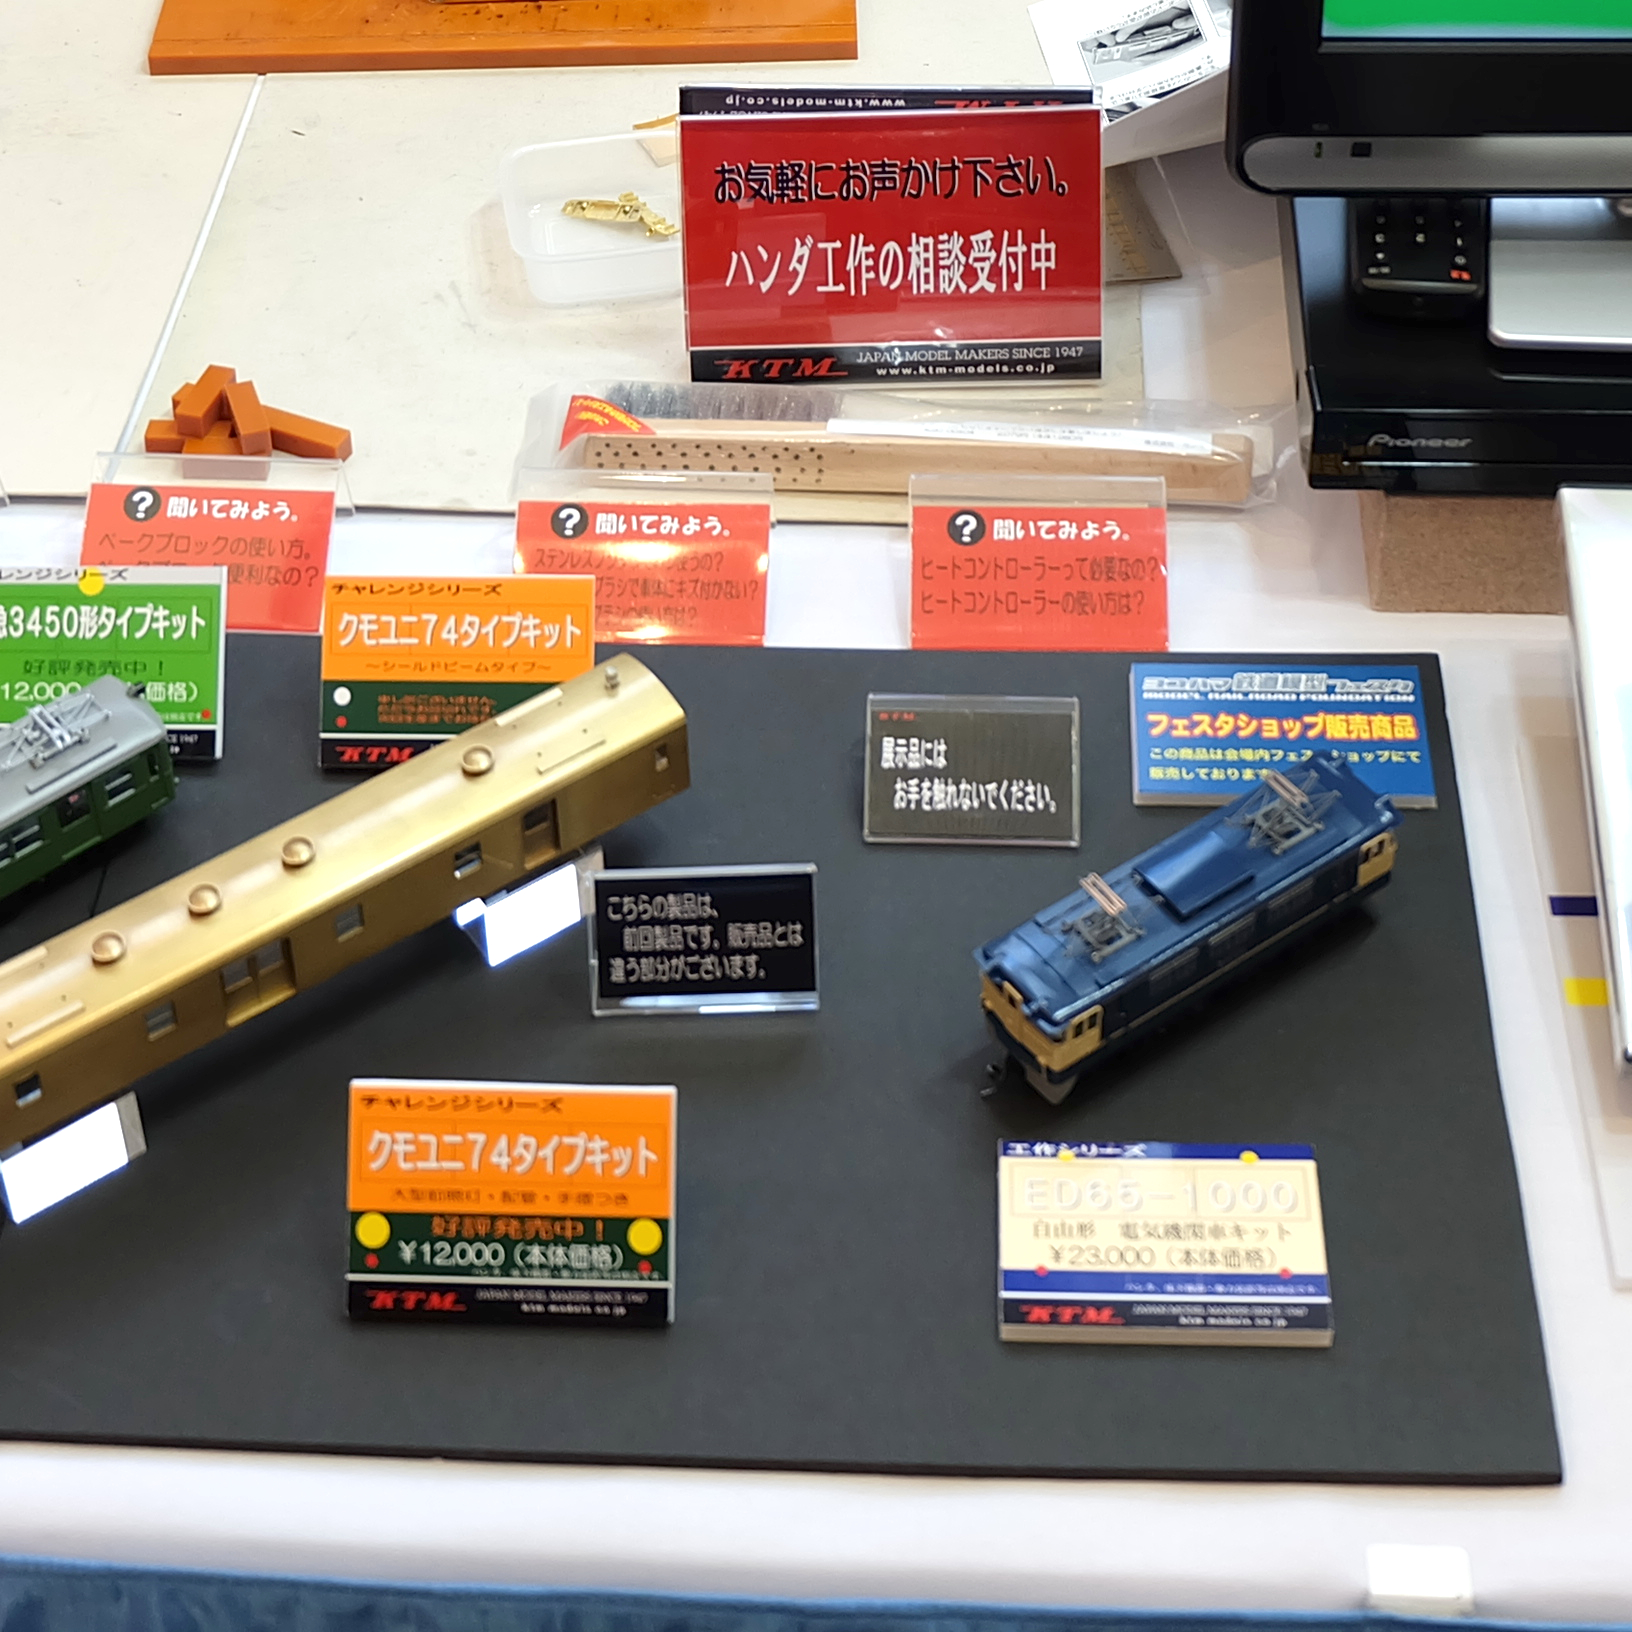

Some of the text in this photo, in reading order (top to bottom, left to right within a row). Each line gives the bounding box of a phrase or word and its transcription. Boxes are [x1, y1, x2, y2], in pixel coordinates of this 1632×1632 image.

[713, 155, 1070, 205] お気軽にお声かけ下さい。
[725, 228, 1057, 297] ハンダ工作の相談受付中
[714, 356, 849, 380] KTM
[856, 347, 1084, 364] JAPAN MODEL MAKERS SINCE 1947
[876, 363, 1056, 377] www.ktm-models.co.jp
[1368, 432, 1474, 450] Pioneer
[167, 494, 300, 523] 聞いてみよう。
[595, 513, 730, 537] 聞いてみよう。
[992, 516, 1132, 544] 聞いてみよう。
[331, 583, 502, 597] チャレンジシリーズ
[339, 611, 582, 649] クモユニ74タイプキット
[1145, 710, 1420, 743] フェスタショップ販売商品
[360, 1094, 564, 1114] チャレンジシリーズ
[368, 1130, 659, 1177] クモユニ74タイプキット
